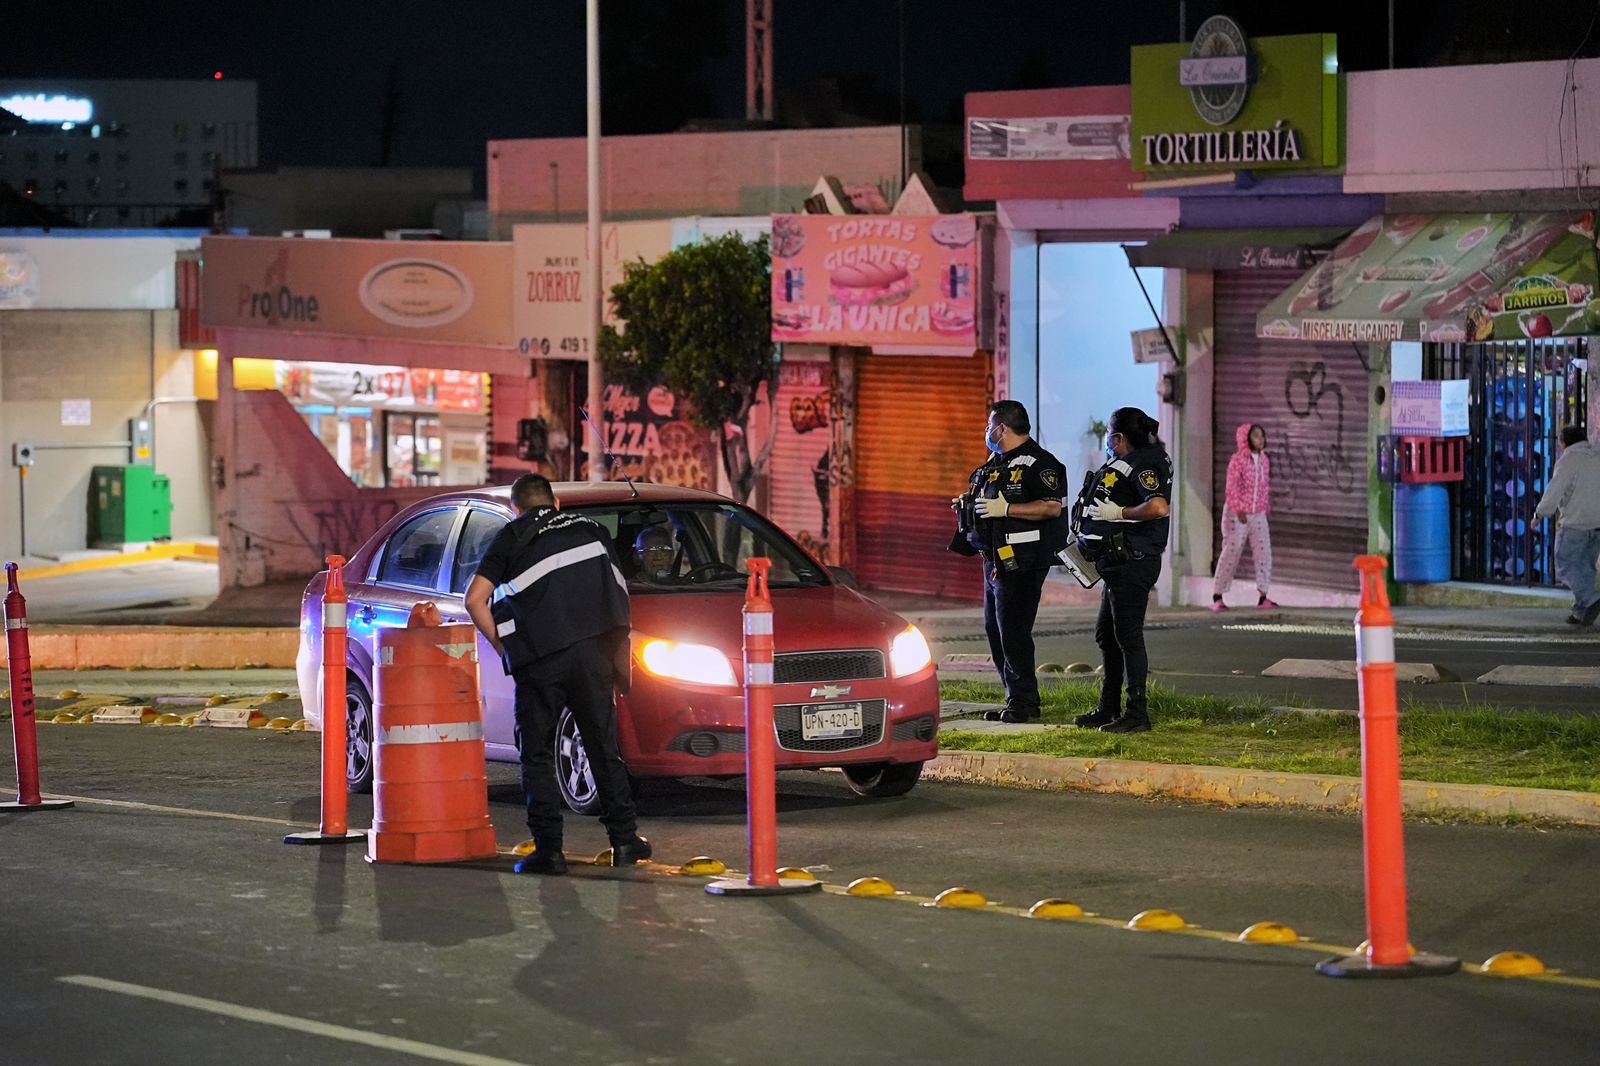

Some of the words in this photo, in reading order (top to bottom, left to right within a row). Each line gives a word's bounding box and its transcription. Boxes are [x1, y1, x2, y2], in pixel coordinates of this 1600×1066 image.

[1141, 119, 1301, 166] TORTILLERÍA
[827, 218, 918, 243] TORTAS
[824, 244, 923, 272] GIGANTES
[527, 271, 582, 303] ZORROZ
[238, 284, 273, 319] Pro
[278, 286, 320, 322] One
[1506, 294, 1566, 310] JARRITOS
[1303, 320, 1358, 341] MISCELANEA
[804, 712, 860, 730] UPN-420-D
